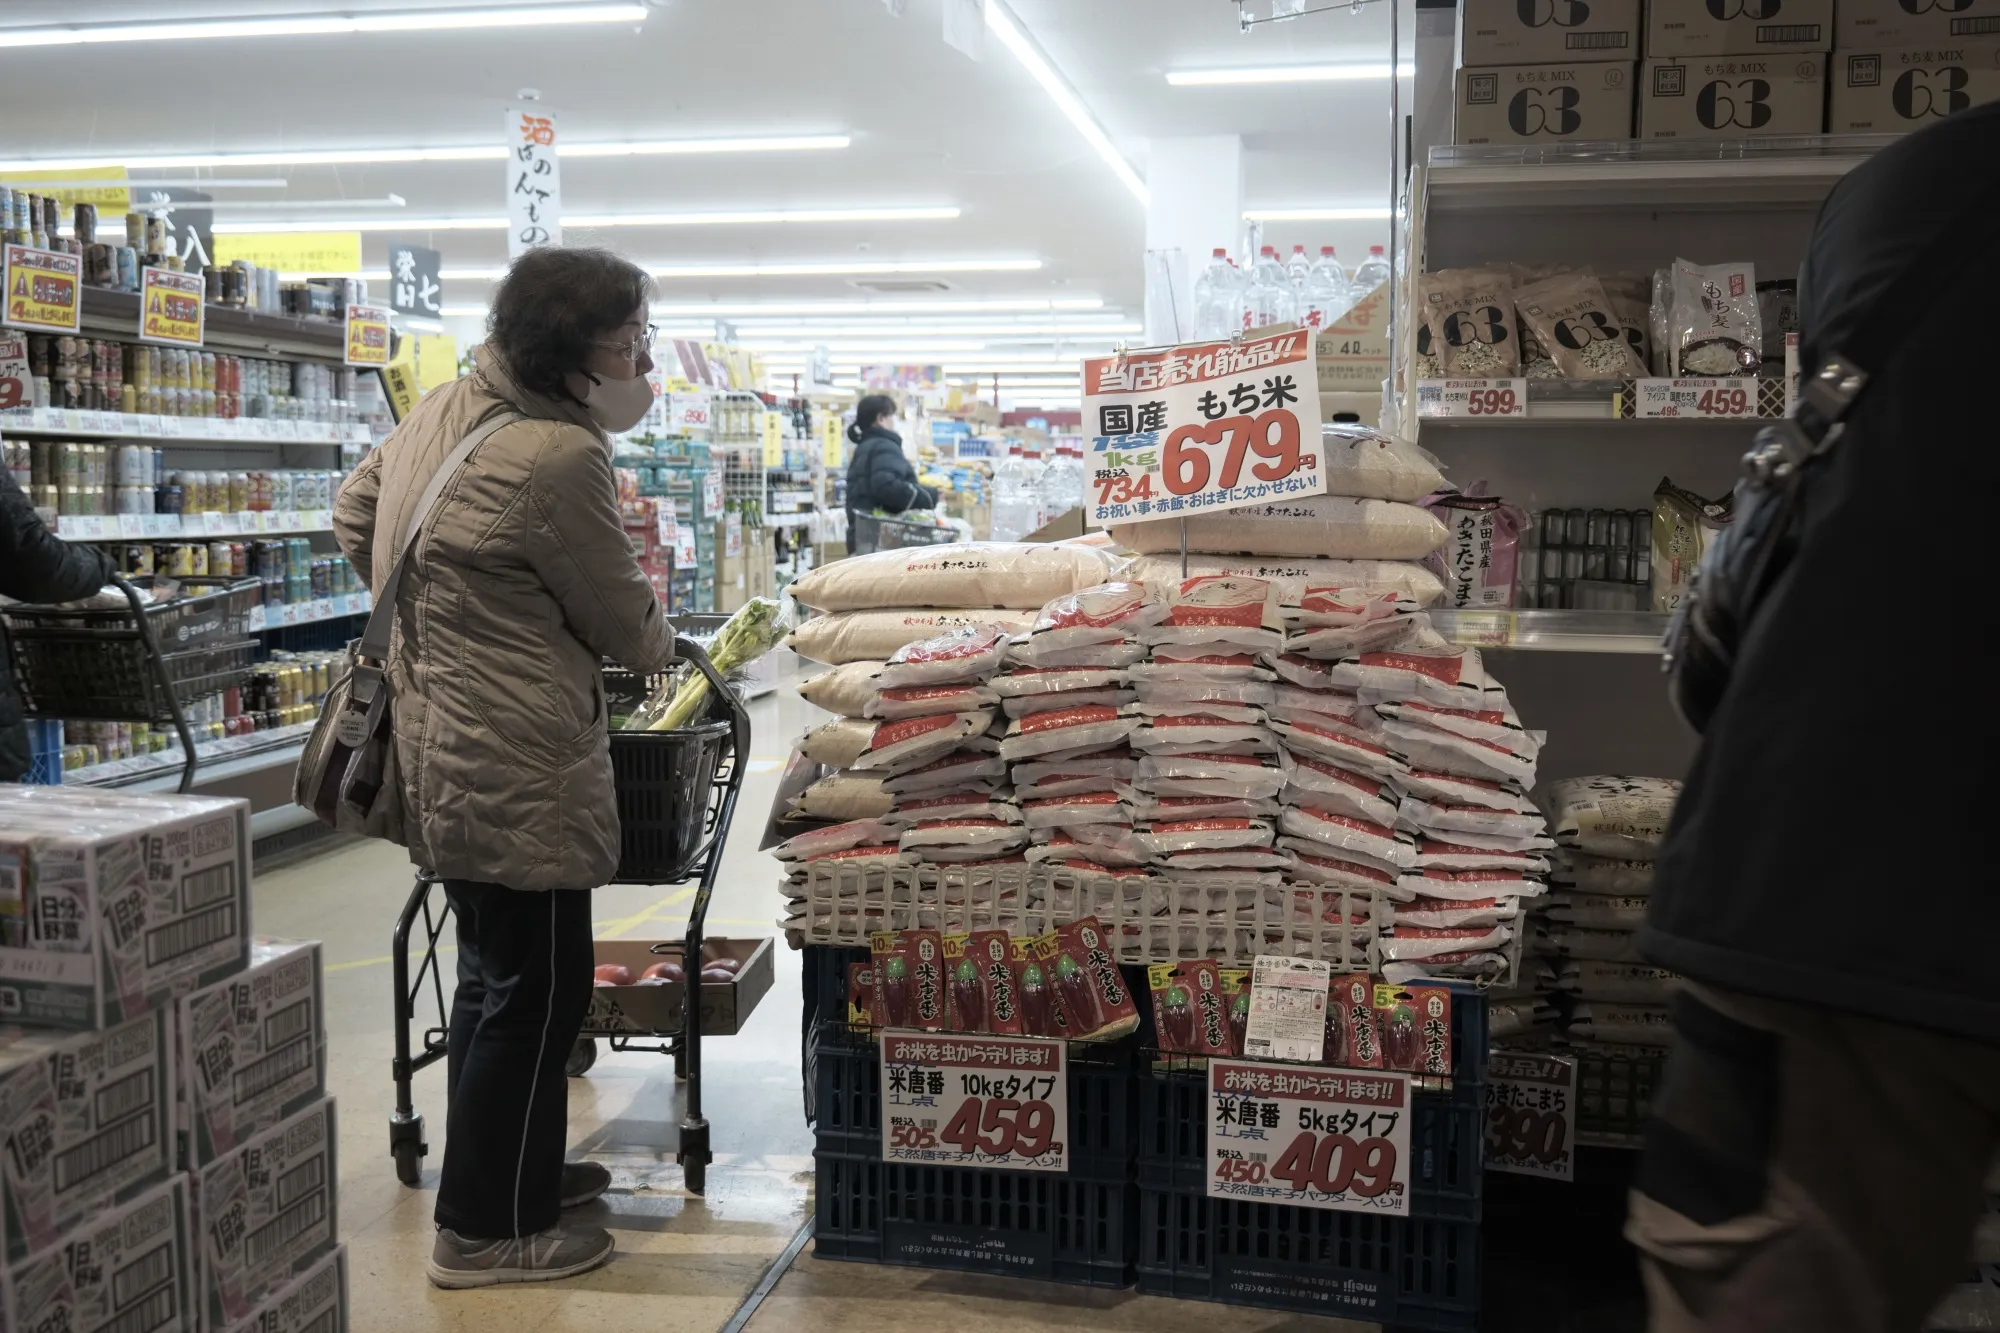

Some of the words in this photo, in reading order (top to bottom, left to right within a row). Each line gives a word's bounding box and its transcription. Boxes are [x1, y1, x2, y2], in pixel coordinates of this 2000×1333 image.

[1704, 63, 1736, 75] もち麦
[1740, 63, 1767, 73] MIX
[1900, 51, 1935, 64] もち麦
[1937, 50, 1964, 62] MIX
[1516, 71, 1548, 83] もち麦
[1550, 70, 1576, 81] MIX
[1696, 79, 1772, 130] 63
[1892, 66, 1970, 119] 63
[1508, 86, 1582, 136] 63
[1475, 294, 1497, 305] MIX
[1575, 300, 1596, 312] MIX
[1704, 281, 1730, 329] もち麦
[1443, 305, 1508, 348] 63
[1554, 311, 1620, 350] 63
[1098, 336, 1298, 392] 当店売れ筋品!!
[1099, 400, 1169, 437] 国産
[1197, 375, 1298, 420] もち米
[1095, 468, 1129, 479] 税込
[1102, 451, 1158, 469] 1kg
[1480, 511, 1493, 569] 秋田県産
[1185, 616, 1220, 626] もち米
[1384, 657, 1418, 670] もち米
[892, 726, 919, 741] もち米
[1419, 929, 1451, 938] もち米
[915, 962, 938, 1021] 米唐番
[988, 962, 1014, 1021] 米唐番
[1087, 949, 1124, 1006] 米唐番
[1198, 991, 1224, 1048] 米唐番
[1350, 1004, 1376, 1060] 米唐番
[894, 1041, 1050, 1066] お米を虫から守ります!
[889, 1070, 945, 1095] 米唐番
[961, 1074, 1056, 1100] 10kgタイプ
[1224, 1070, 1394, 1099] お米を虫から守ります!!
[890, 1116, 915, 1127] 税込
[1216, 1099, 1280, 1128] 米唐番
[1299, 1107, 1399, 1137] 5kgタイプ
[1216, 1148, 1243, 1160] 税込
[1343, 1280, 1377, 1292] meiji
